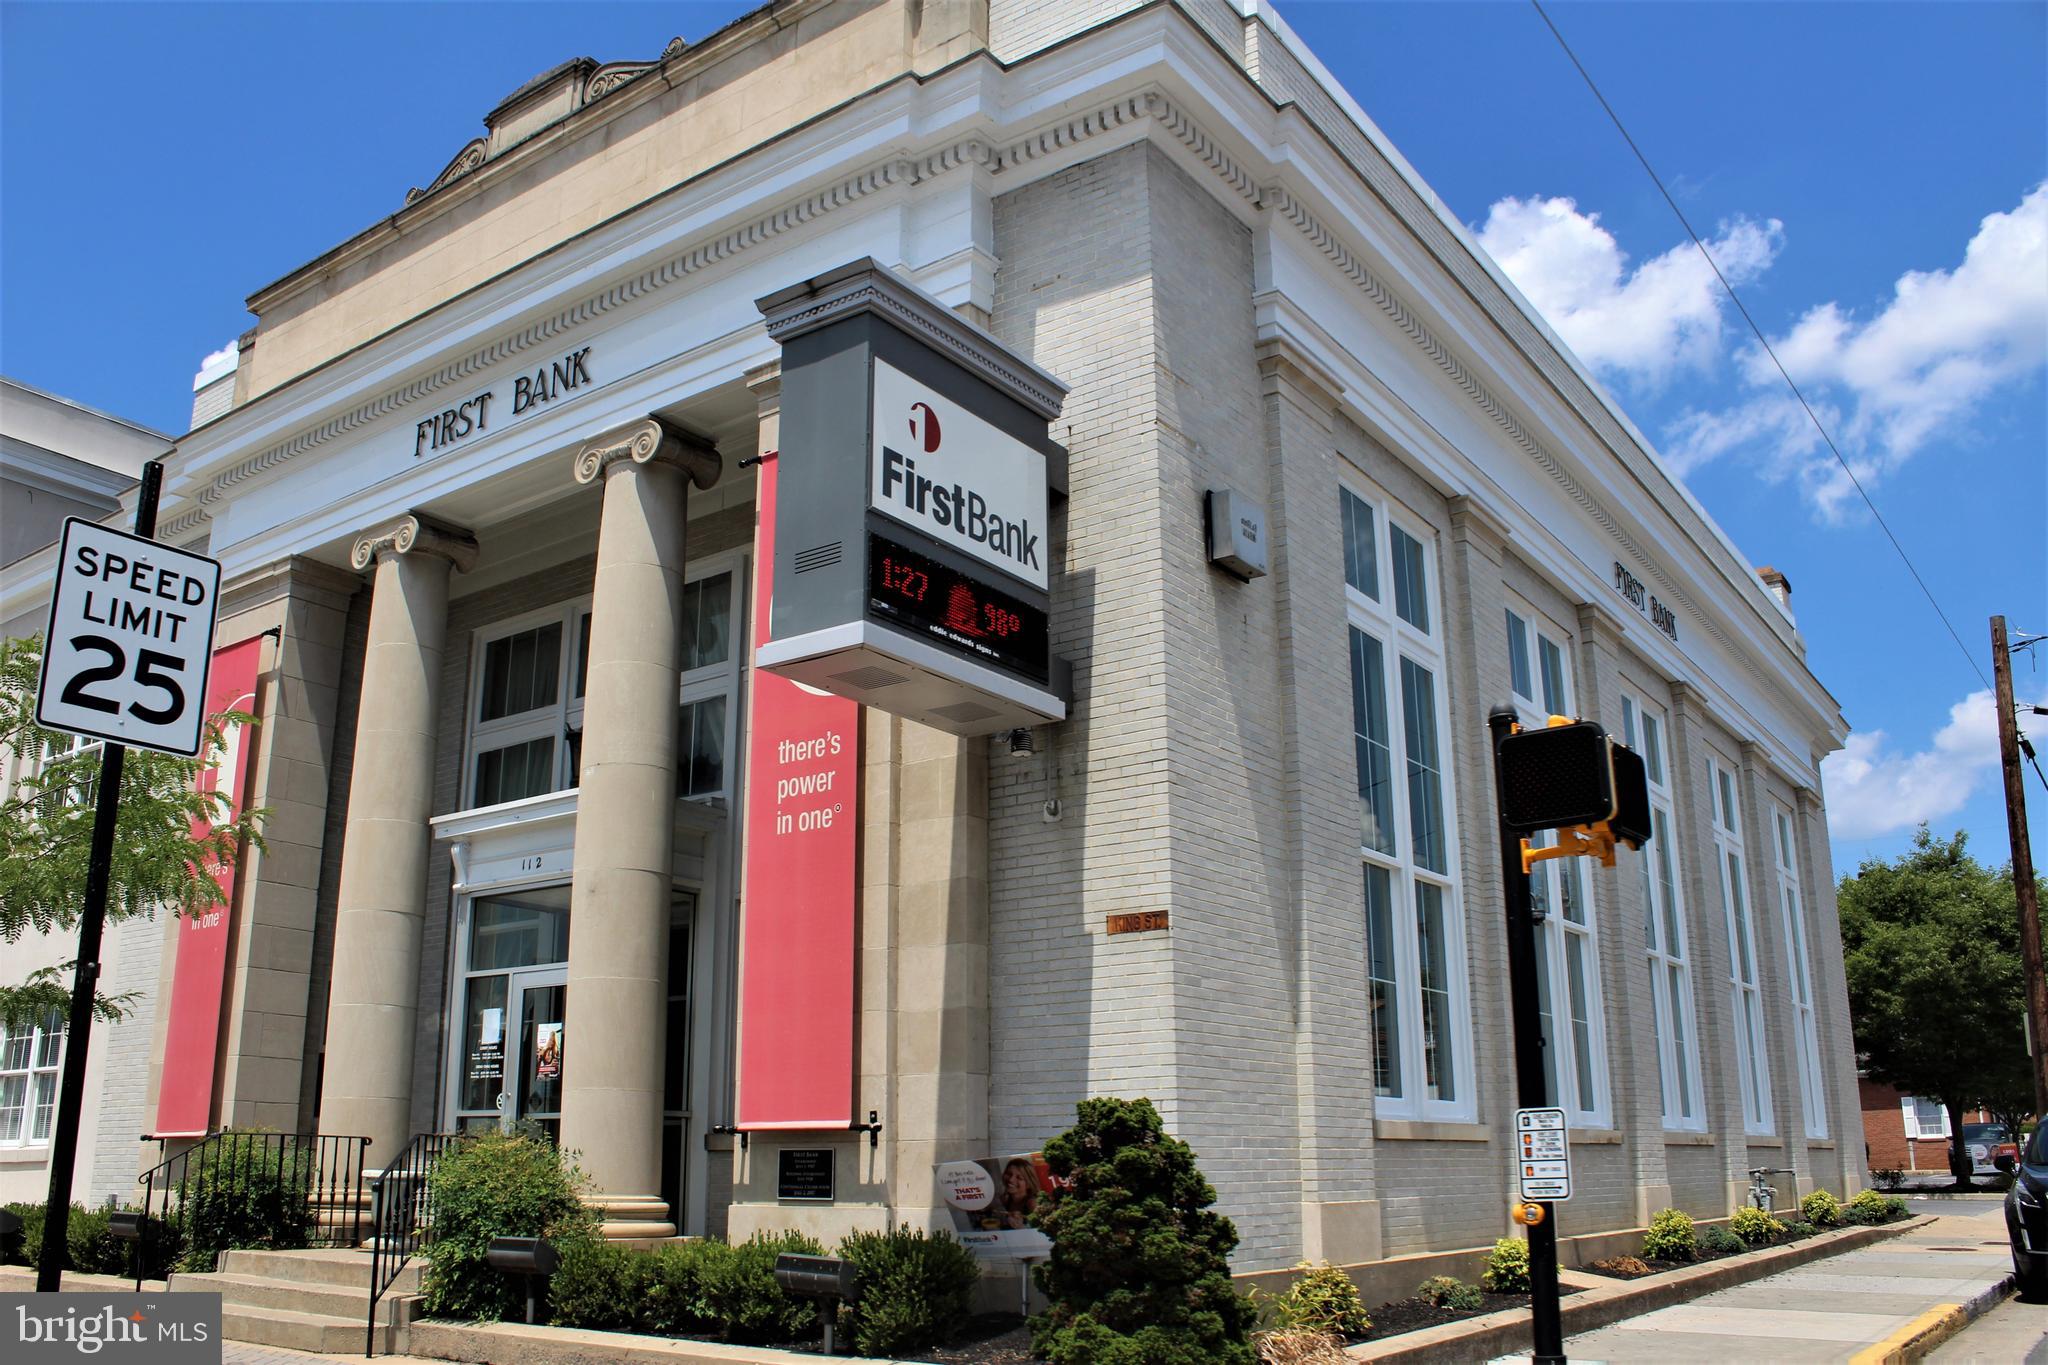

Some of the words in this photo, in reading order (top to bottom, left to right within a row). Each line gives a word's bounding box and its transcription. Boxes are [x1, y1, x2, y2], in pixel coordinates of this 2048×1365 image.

[414, 391, 493, 457] FIRST
[512, 346, 591, 415] BANK
[882, 445, 1039, 571] FirstBank
[74, 546, 205, 606] SPEED
[882, 558, 928, 600] 1:27
[83, 590, 187, 643] LIMIT
[1614, 561, 1645, 611] FIRST
[1650, 595, 1678, 641] BANK
[60, 634, 185, 725] 25
[778, 731, 841, 764] there's
[777, 770, 836, 804] power
[777, 811, 792, 835] in
[522, 856, 542, 870] 112
[1114, 916, 1140, 932] KING
